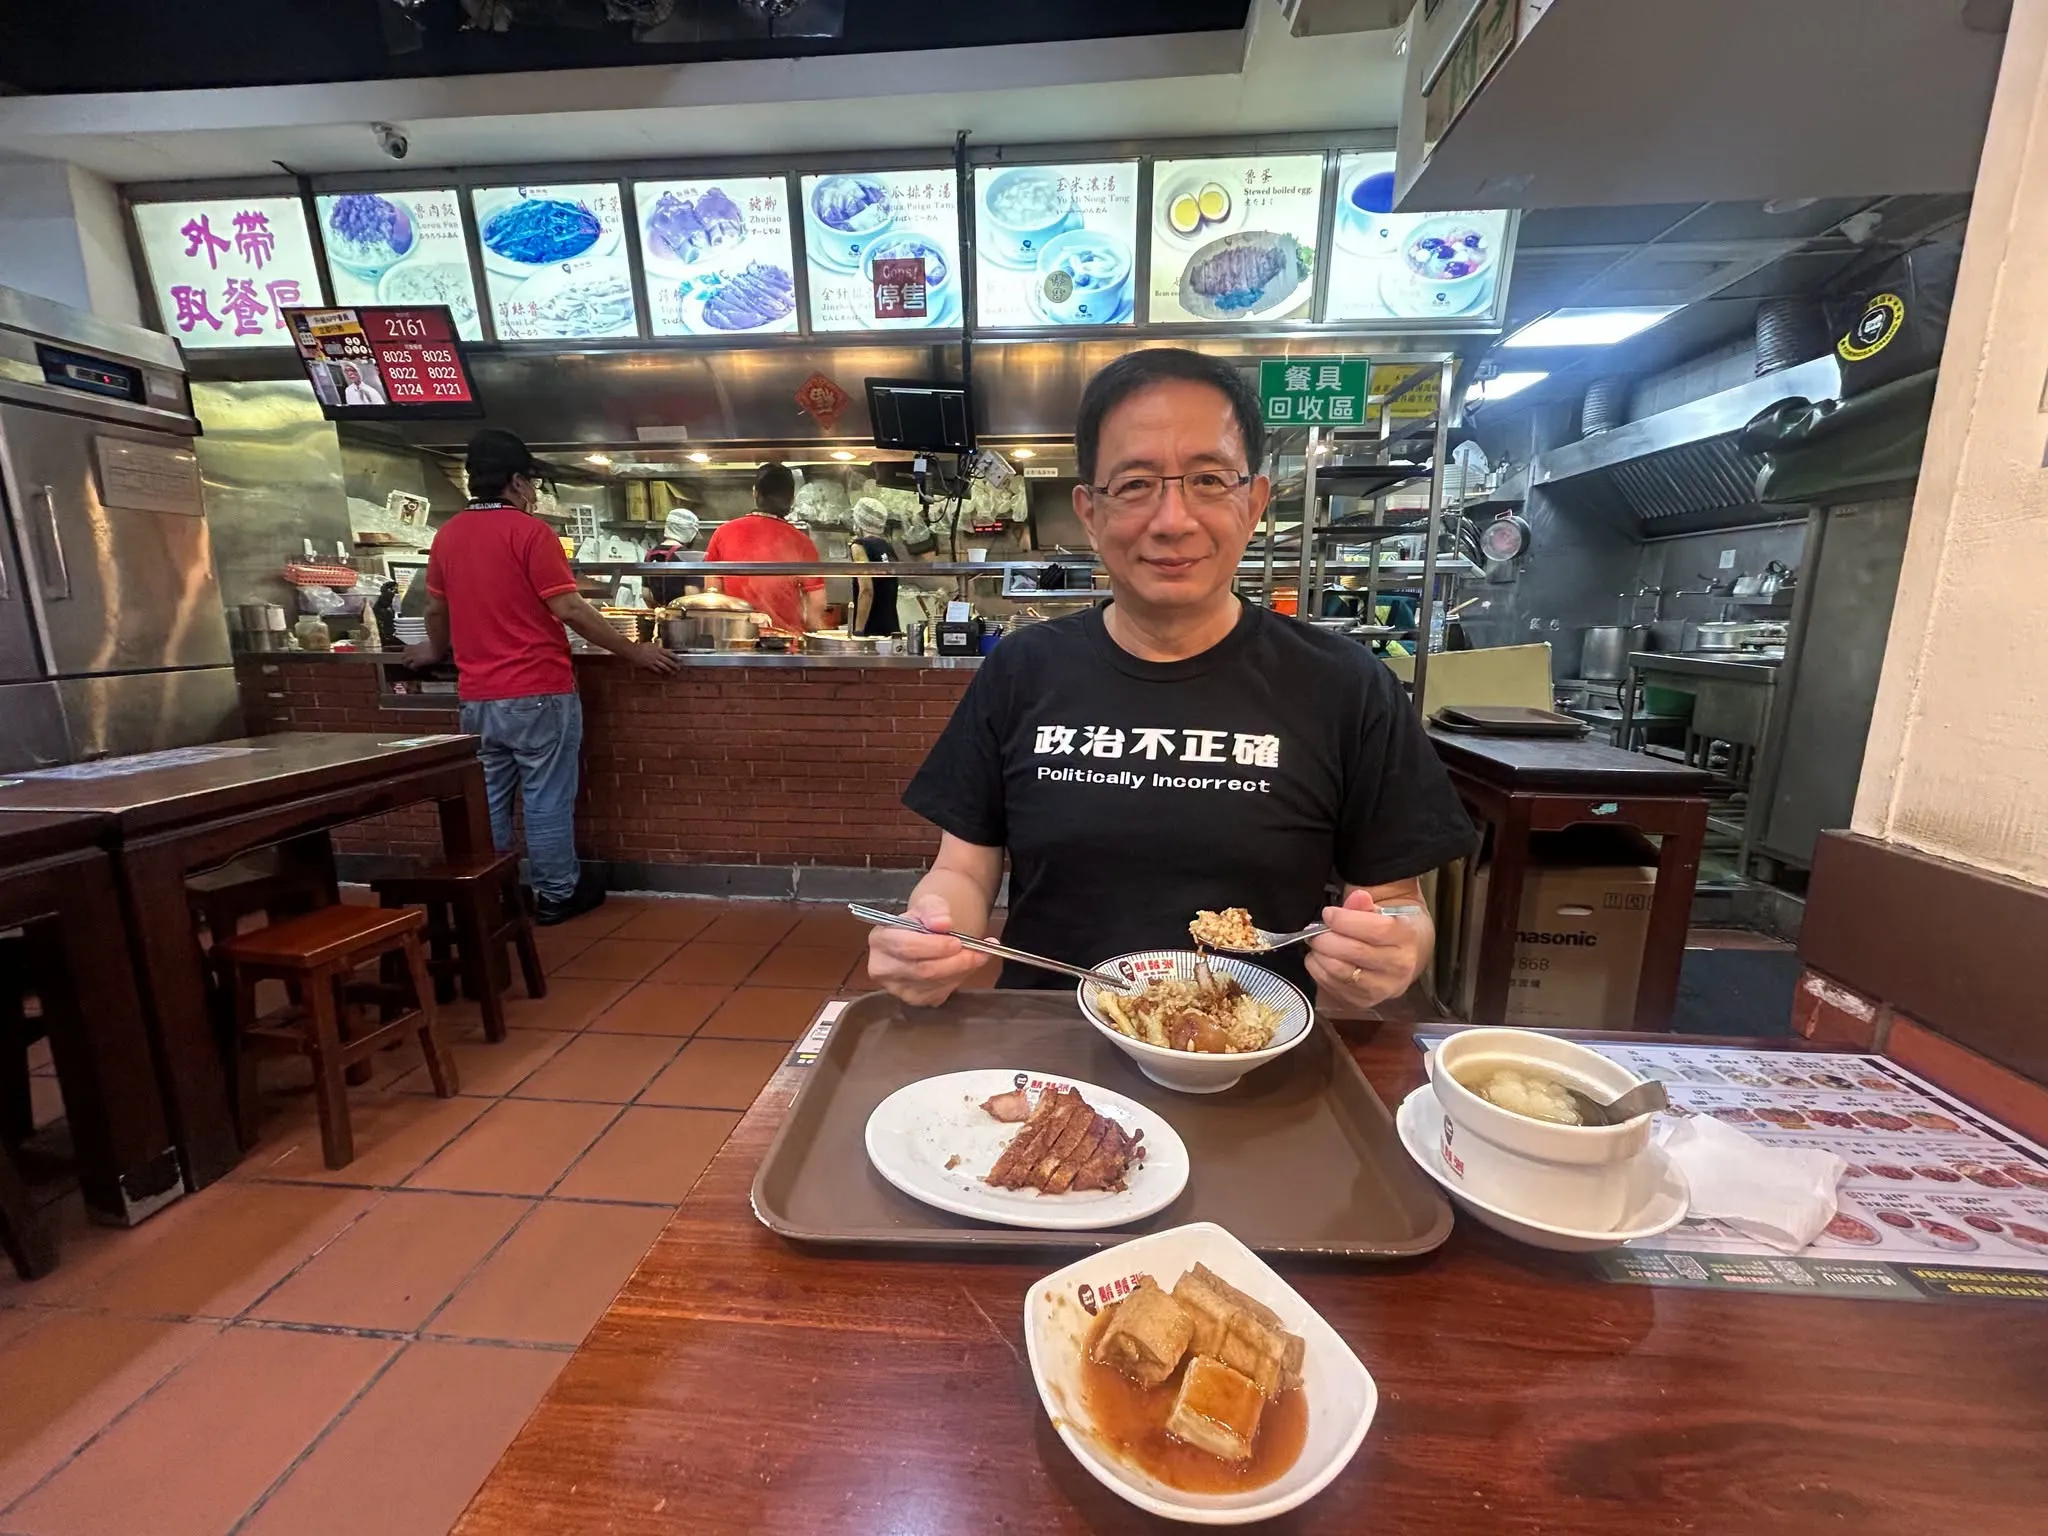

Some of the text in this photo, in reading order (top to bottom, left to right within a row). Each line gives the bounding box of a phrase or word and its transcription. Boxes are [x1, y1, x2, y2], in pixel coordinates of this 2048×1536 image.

[1056, 175, 1117, 193] 玉米濃湯
[1243, 188, 1271, 196] Stewed
[1272, 187, 1296, 195] boiled
[181, 210, 275, 270] 外帶
[875, 283, 925, 311] 停售
[385, 318, 428, 337] 2161
[383, 350, 452, 363] 8025 8025
[389, 367, 458, 380] 8022 8022
[1285, 365, 1343, 392] 餐具
[394, 383, 462, 396] 2124 2121
[1268, 395, 1356, 420] 回收區
[1034, 724, 1280, 768] 政治不正確
[1037, 766, 1271, 793] Politically Incorrect
[1515, 929, 1598, 947] nasonic
